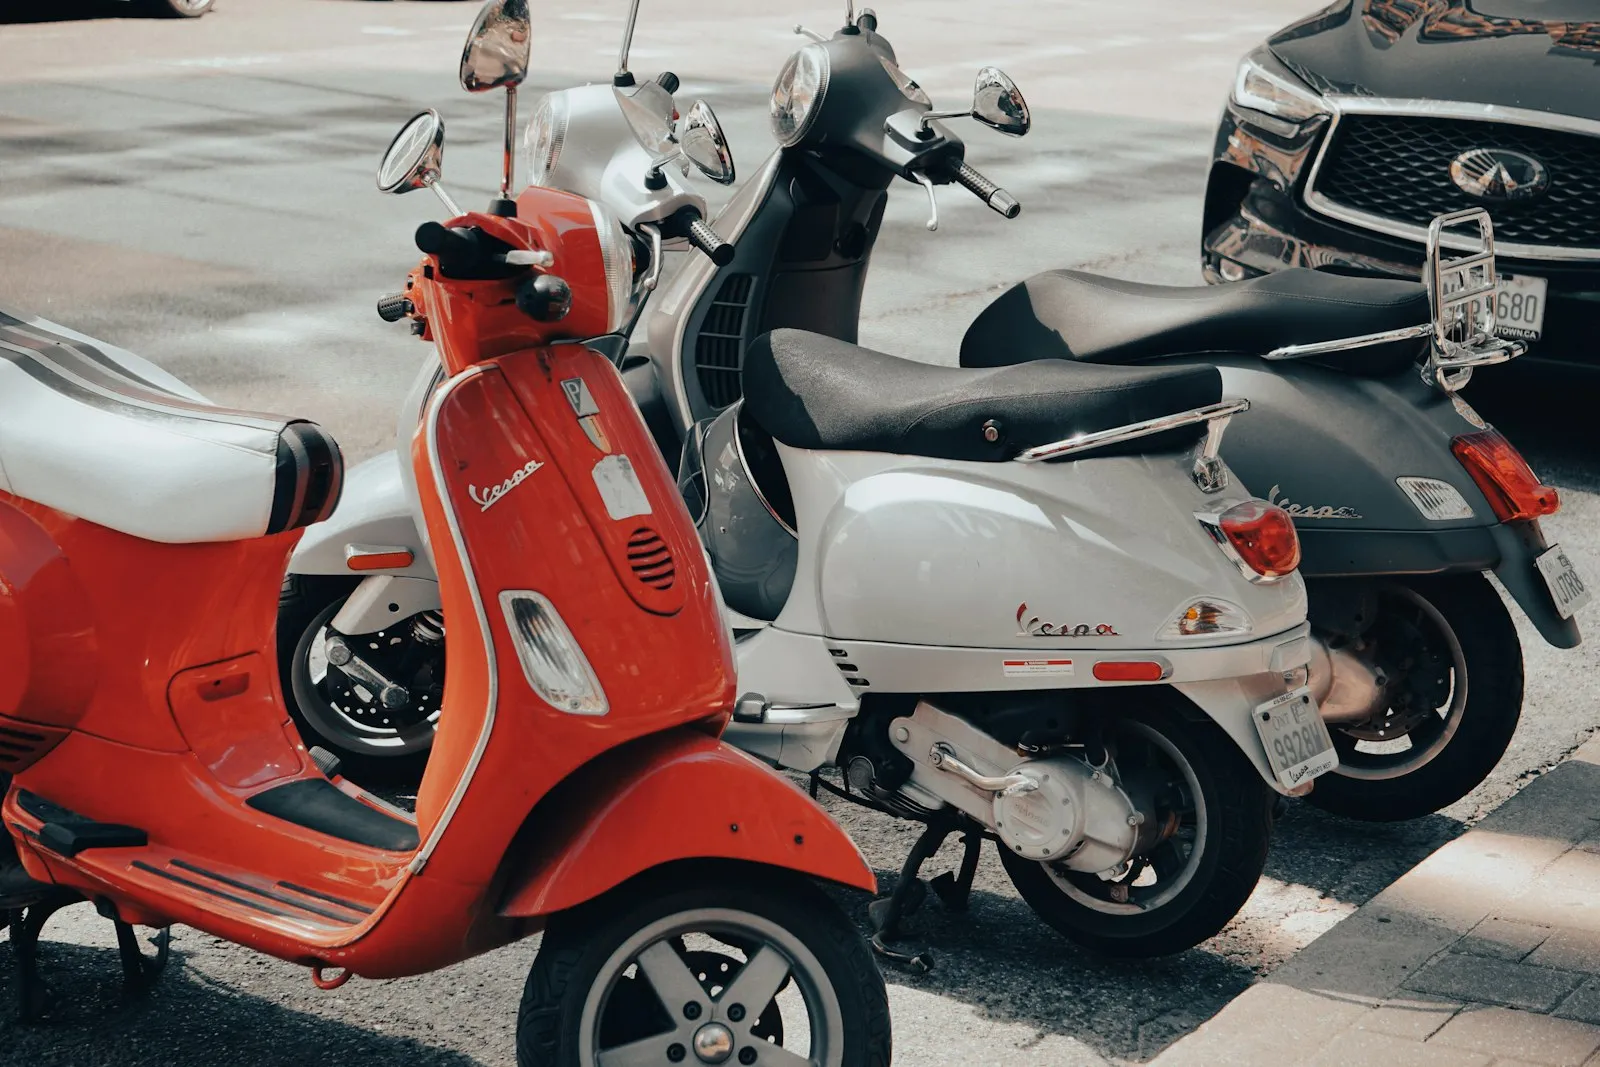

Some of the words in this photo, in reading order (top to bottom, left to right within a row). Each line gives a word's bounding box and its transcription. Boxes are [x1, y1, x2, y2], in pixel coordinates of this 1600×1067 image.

[1497, 290, 1538, 324] 680
[468, 459, 545, 513] Vespa
[1268, 483, 1363, 519] Vespa
[1015, 600, 1122, 638] Vespa
[1289, 765, 1309, 784] Vespa
[1306, 765, 1323, 778] TORONTO
[1322, 760, 1332, 770] WEST
